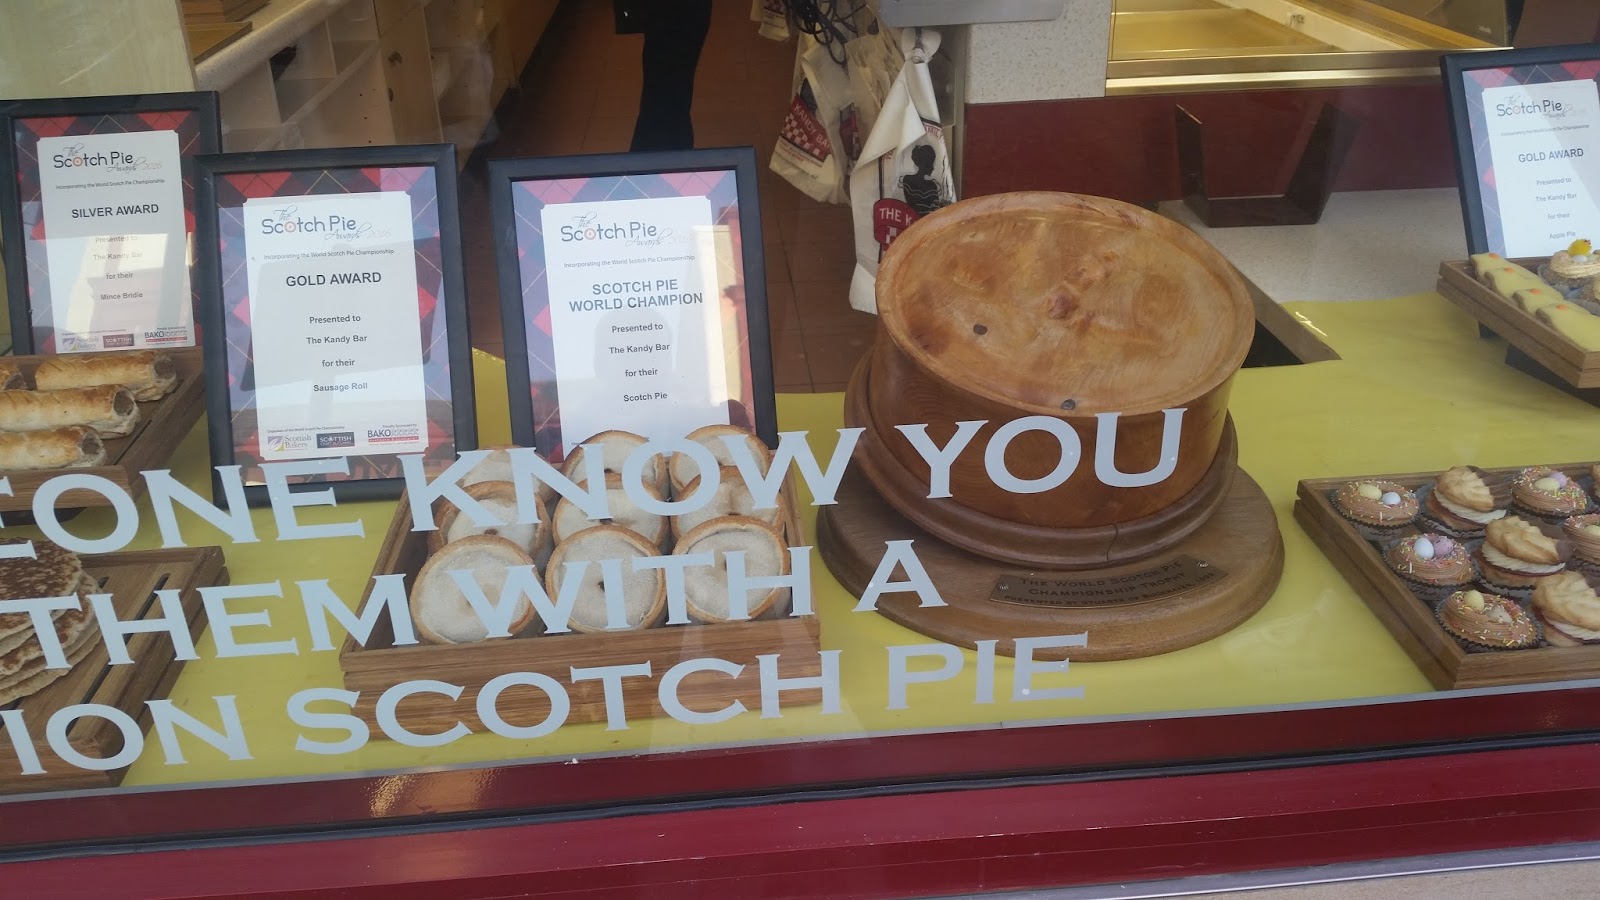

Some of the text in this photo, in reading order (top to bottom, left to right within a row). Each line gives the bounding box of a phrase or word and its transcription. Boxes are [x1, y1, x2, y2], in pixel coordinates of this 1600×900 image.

[1496, 100, 1541, 116] Scotch
[1542, 99, 1563, 112] Pie
[53, 151, 133, 169] Scotch Pie
[1518, 148, 1584, 163] GOLD AWARD
[132, 178, 166, 186] Championship
[1536, 177, 1565, 186] Presented
[71, 204, 159, 219] SILVER AWARD
[879, 208, 902, 222] THE
[261, 215, 356, 235] Scotch Pie
[560, 221, 657, 242] Scotch Pie
[107, 251, 129, 260] Kandy
[355, 248, 394, 256] Championship
[656, 254, 696, 263] Championship
[106, 271, 133, 280] for their
[285, 271, 381, 287] GOLD AWARD
[592, 278, 679, 295] SCOTCH PIE
[100, 291, 143, 300] Mince Bridie
[569, 293, 703, 313] WORLD CHAMPION
[309, 314, 351, 324] Presented
[611, 322, 663, 333] Presented to
[144, 331, 164, 339] BAKO
[306, 334, 368, 344] The Kandy Bar
[609, 343, 670, 354] The Kandy Bar
[321, 358, 355, 367] for their
[624, 368, 658, 377] for their
[313, 382, 368, 392] Sausage Roll
[623, 392, 668, 402] Scotch Pie
[284, 434, 312, 442] Scottish
[368, 429, 392, 438] BAKO
[398, 427, 866, 532] KNOW
[894, 408, 1187, 499] YOU
[1019, 578, 1048, 587] THE
[1110, 568, 1161, 585] SCOTCH
[1161, 560, 1182, 572] PIE
[1028, 571, 1187, 596] CHAMPIONSHIP TROPHY
[0, 539, 948, 669] THEM WITH A
[286, 649, 843, 755] SCOTCH
[885, 631, 1089, 710] PIE
